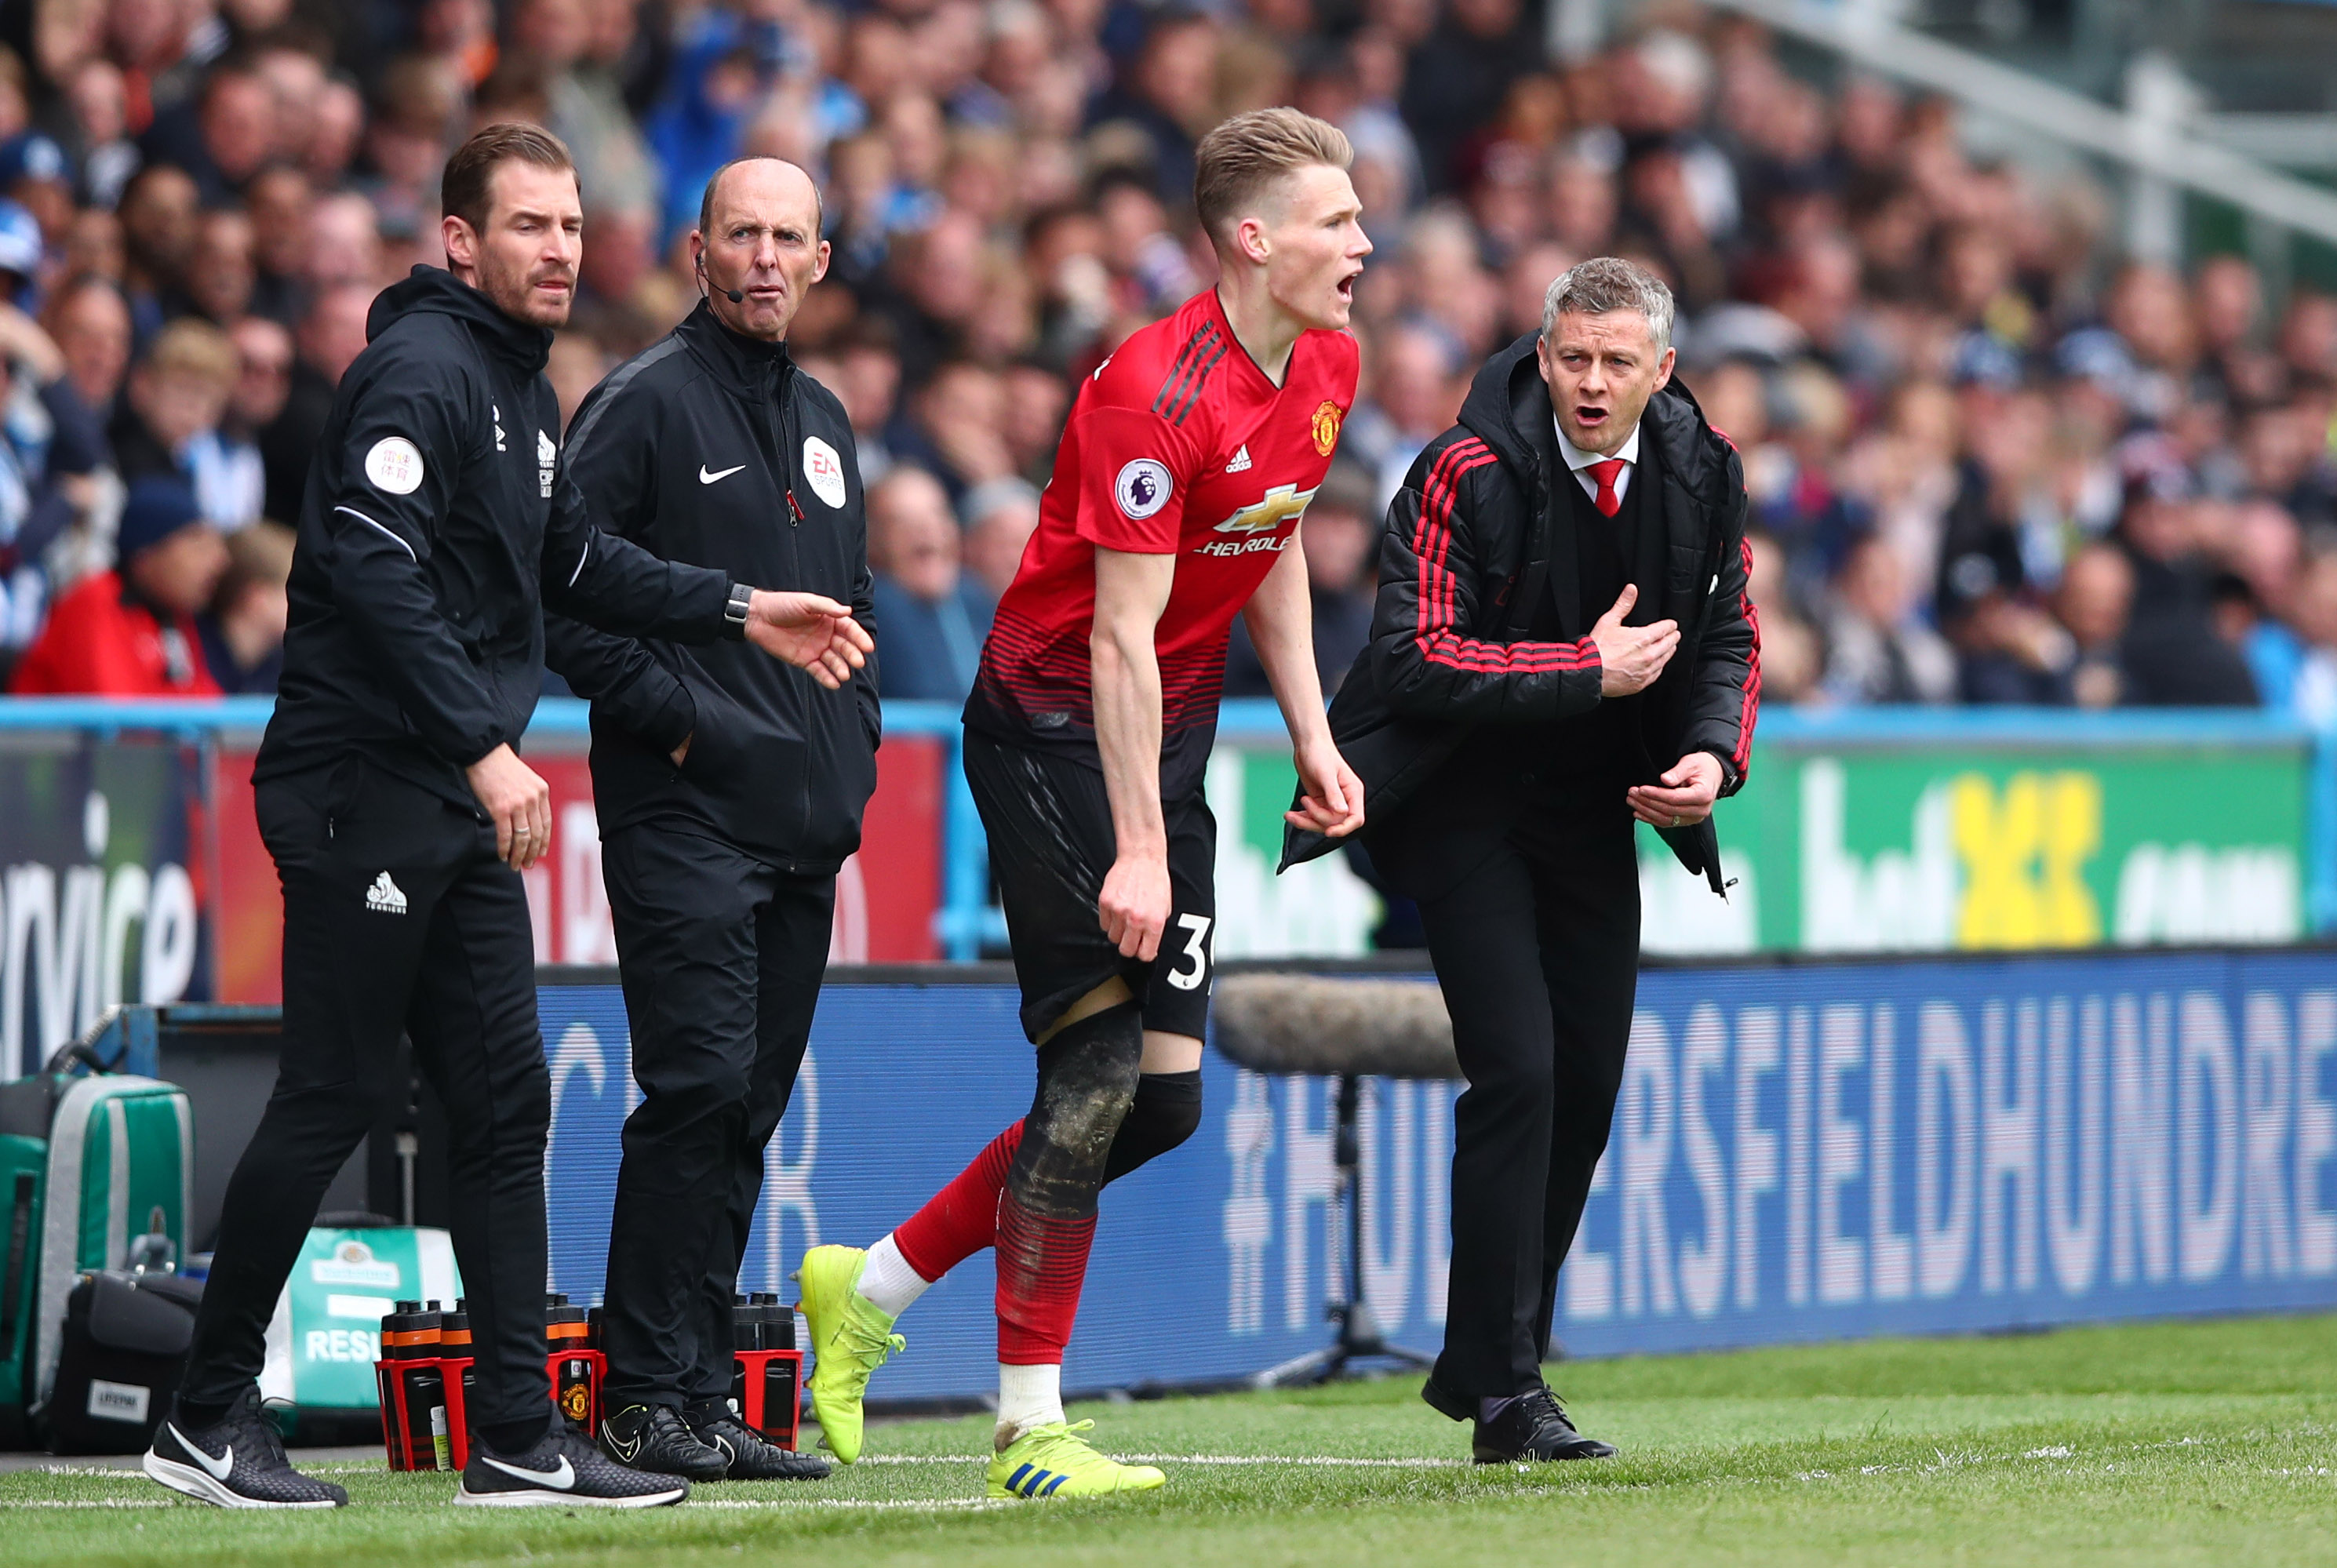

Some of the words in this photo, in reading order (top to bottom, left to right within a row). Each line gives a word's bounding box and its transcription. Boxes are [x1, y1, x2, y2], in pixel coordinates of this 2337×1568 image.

[813, 452, 839, 478] EA
[1225, 460, 1252, 473] adidas
[814, 475, 843, 490] SPORTS
[1193, 537, 1291, 556] HEVROLE
[1167, 913, 1215, 995] 3
